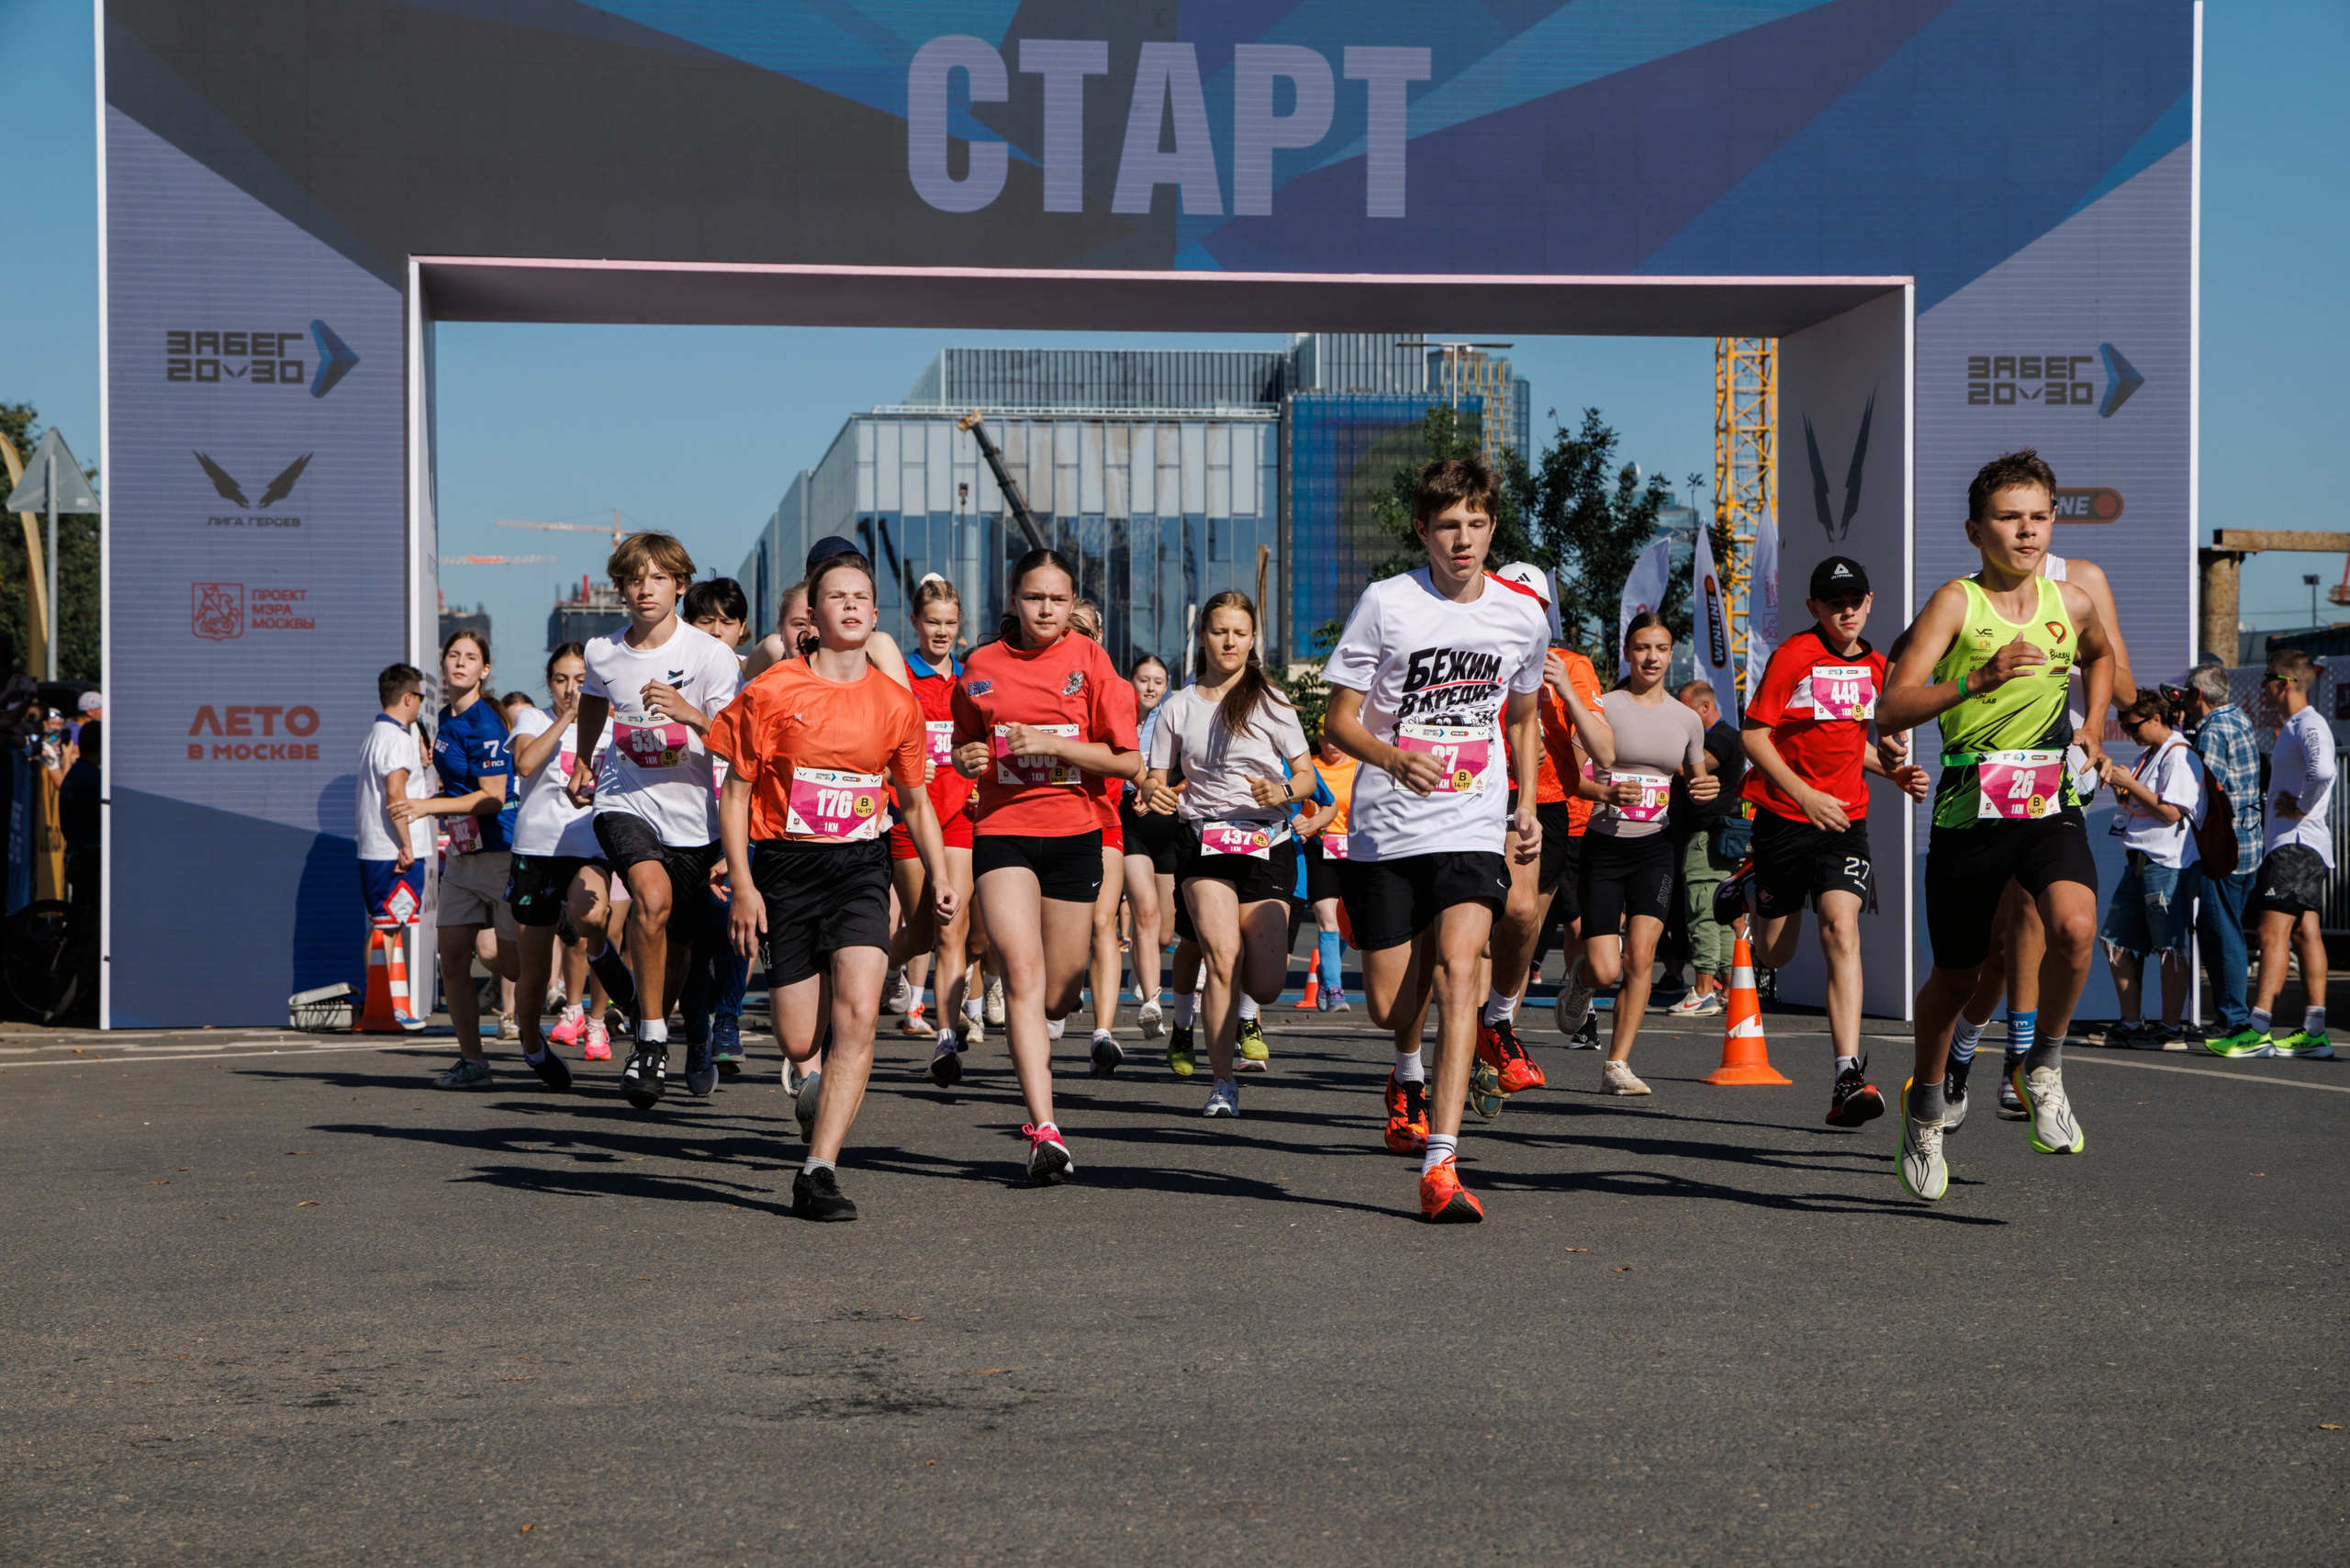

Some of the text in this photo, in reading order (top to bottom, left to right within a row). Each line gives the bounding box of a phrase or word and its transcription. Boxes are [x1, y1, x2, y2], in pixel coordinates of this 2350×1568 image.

[907, 34, 1432, 218] СТАРТ
[166, 330, 304, 358] ЗАБЕГ
[1967, 355, 2094, 381] ЗАБЕГ
[207, 517, 301, 528] ЛИГА ГЕРОЕВ
[252, 589, 308, 601] ПРОЕКТ
[252, 604, 293, 615] МЭРА
[252, 618, 315, 629] МОСКВЫ
[1707, 595, 1724, 662] WINLINE
[1402, 647, 1502, 693] БЕЖИМ
[1831, 681, 1860, 704] 448
[1397, 684, 1501, 719] В КРЕДИТ
[188, 705, 319, 737] ЛЕТО
[483, 740, 499, 757] 7
[631, 728, 667, 753] 530
[187, 744, 319, 760] В МОСКВЕ
[644, 756, 658, 765] 1 KM
[1031, 773, 1045, 781] 1 KM
[1056, 767, 1063, 776] B
[1459, 772, 1467, 780] B
[2008, 769, 2036, 799] 26
[816, 789, 854, 818] 176
[861, 798, 868, 806] B
[2015, 804, 2024, 814] KM
[2033, 797, 2041, 806] B
[824, 822, 838, 833] 1 KM
[1220, 830, 1253, 846] 437
[1843, 857, 1871, 880] 27
